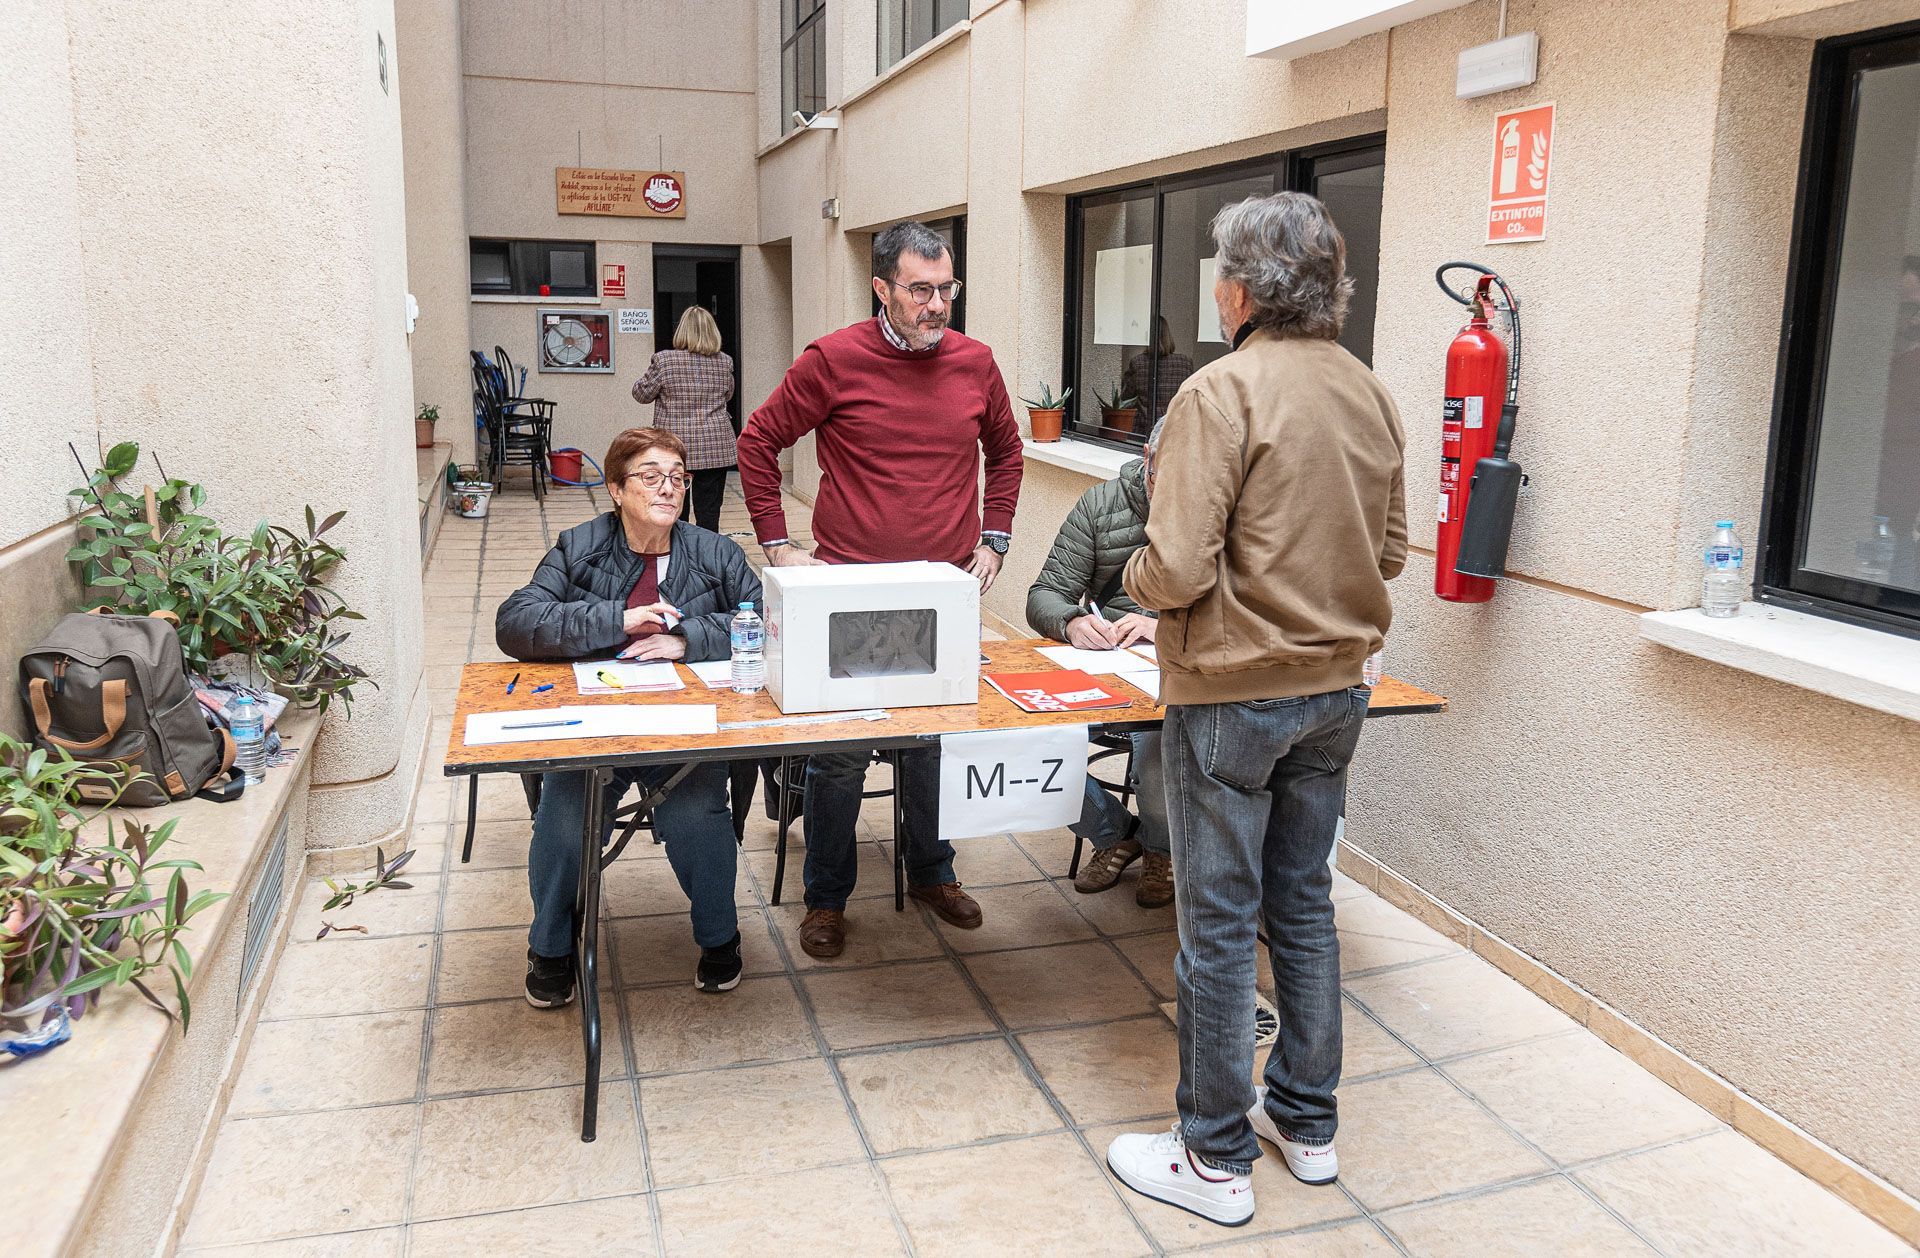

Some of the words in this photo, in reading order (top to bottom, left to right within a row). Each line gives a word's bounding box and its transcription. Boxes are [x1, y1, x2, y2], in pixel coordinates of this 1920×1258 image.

[601, 172, 619, 180] Escuela
[620, 173, 636, 182] Vicent
[650, 178, 675, 190] UGT
[561, 194, 566, 202] y
[1490, 206, 1544, 222] EXTINTOR
[1013, 688, 1070, 711] PSOE
[966, 758, 1064, 800] M--Z
